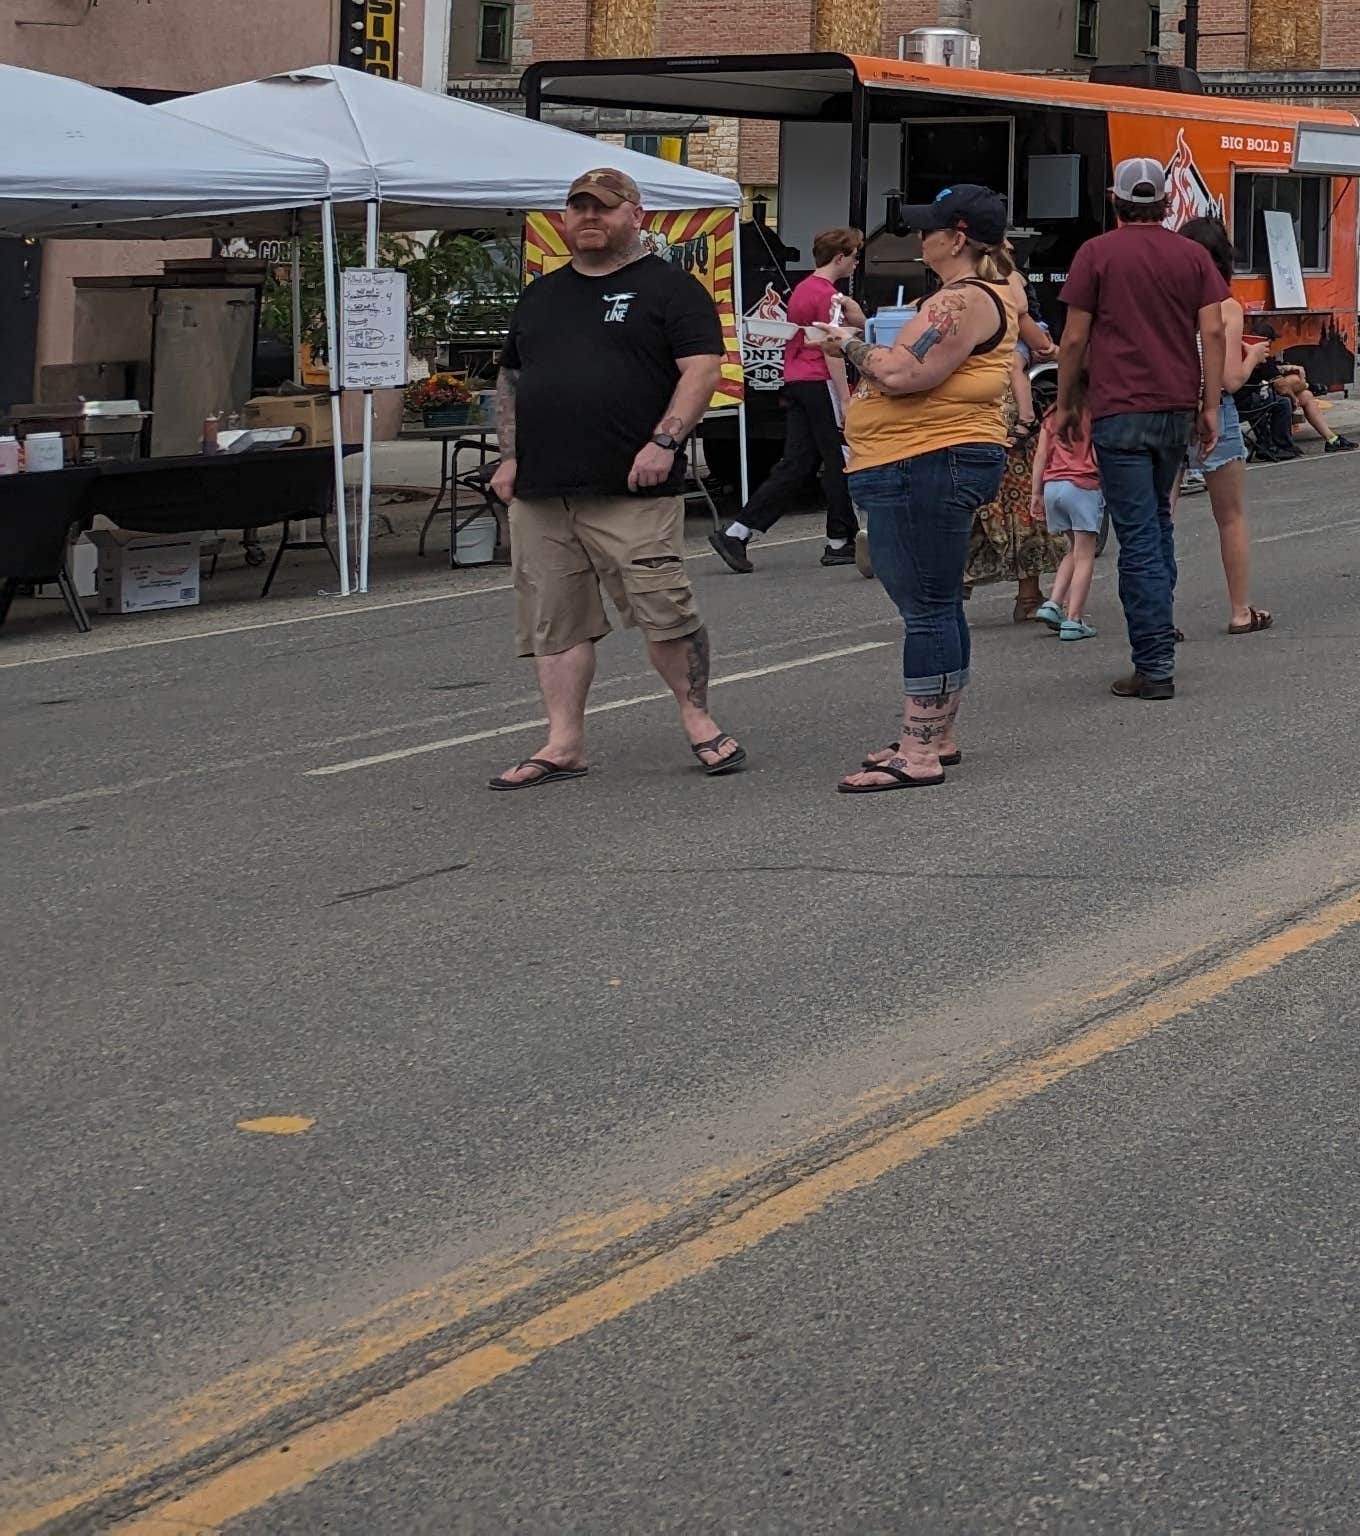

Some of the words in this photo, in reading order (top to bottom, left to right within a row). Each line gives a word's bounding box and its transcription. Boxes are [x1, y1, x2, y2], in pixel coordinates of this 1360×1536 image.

[1221, 136, 1244, 150] BIG
[1247, 139, 1279, 153] BOLD
[604, 310, 626, 323] LINE
[754, 368, 780, 380] BBQ
